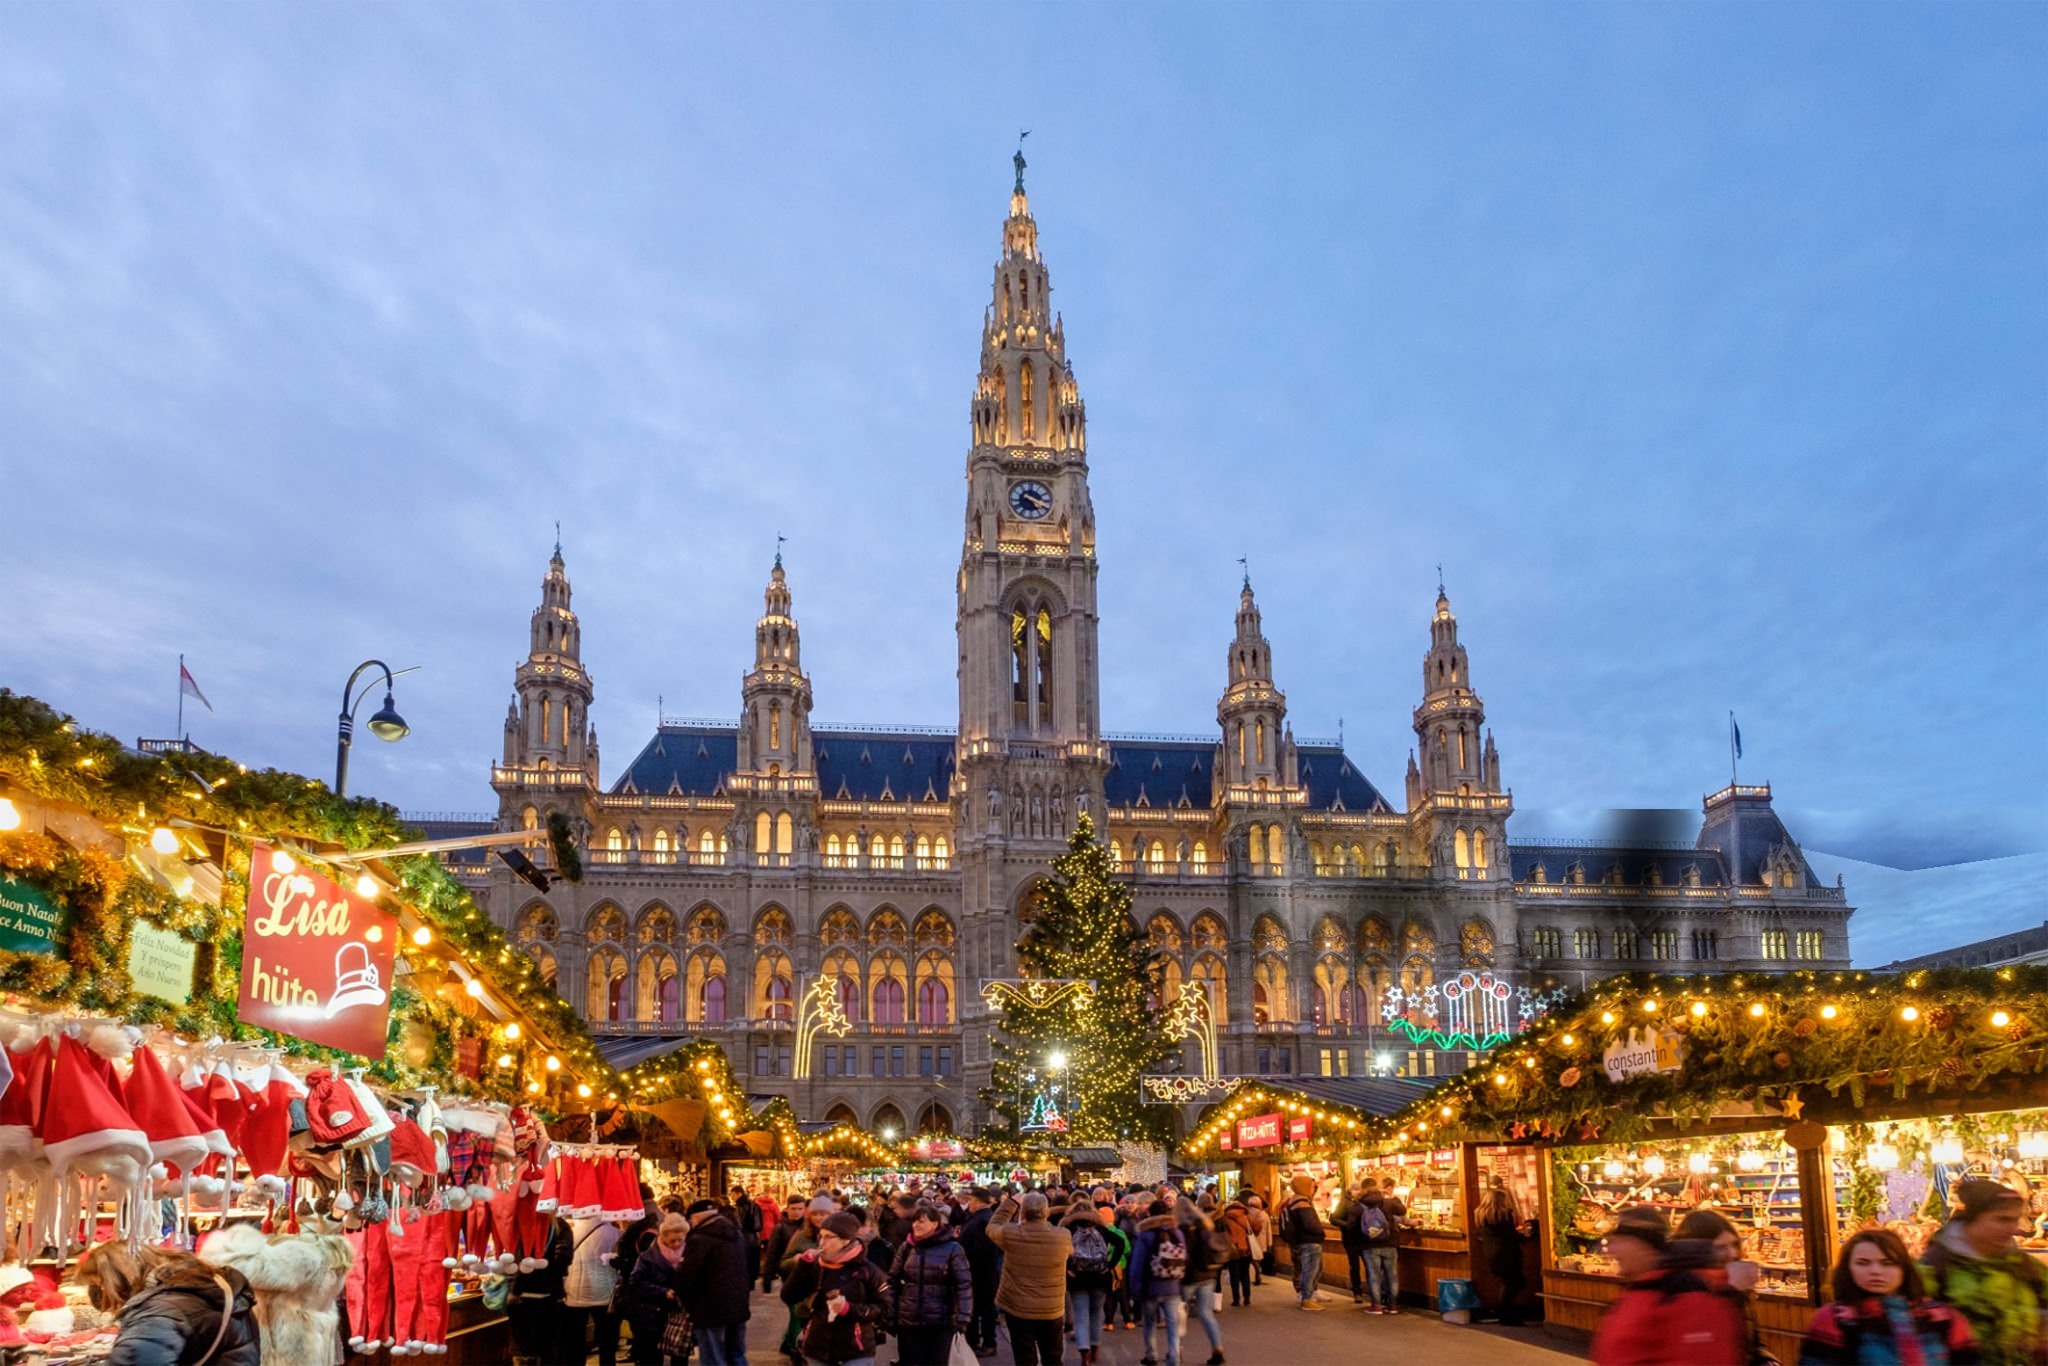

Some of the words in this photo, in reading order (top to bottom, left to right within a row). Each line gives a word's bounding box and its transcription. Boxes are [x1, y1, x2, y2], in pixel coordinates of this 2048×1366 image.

[0, 893, 24, 913] uon
[26, 902, 64, 925] Natale
[254, 873, 351, 937] Lisa
[13, 918, 45, 937] Anno
[134, 931, 155, 948] Feliz
[156, 939, 190, 959] Navidad
[141, 949, 148, 961] Y
[156, 971, 182, 988] Nuevo
[251, 956, 318, 1010] hüte
[1607, 1045, 1667, 1071] constantin
